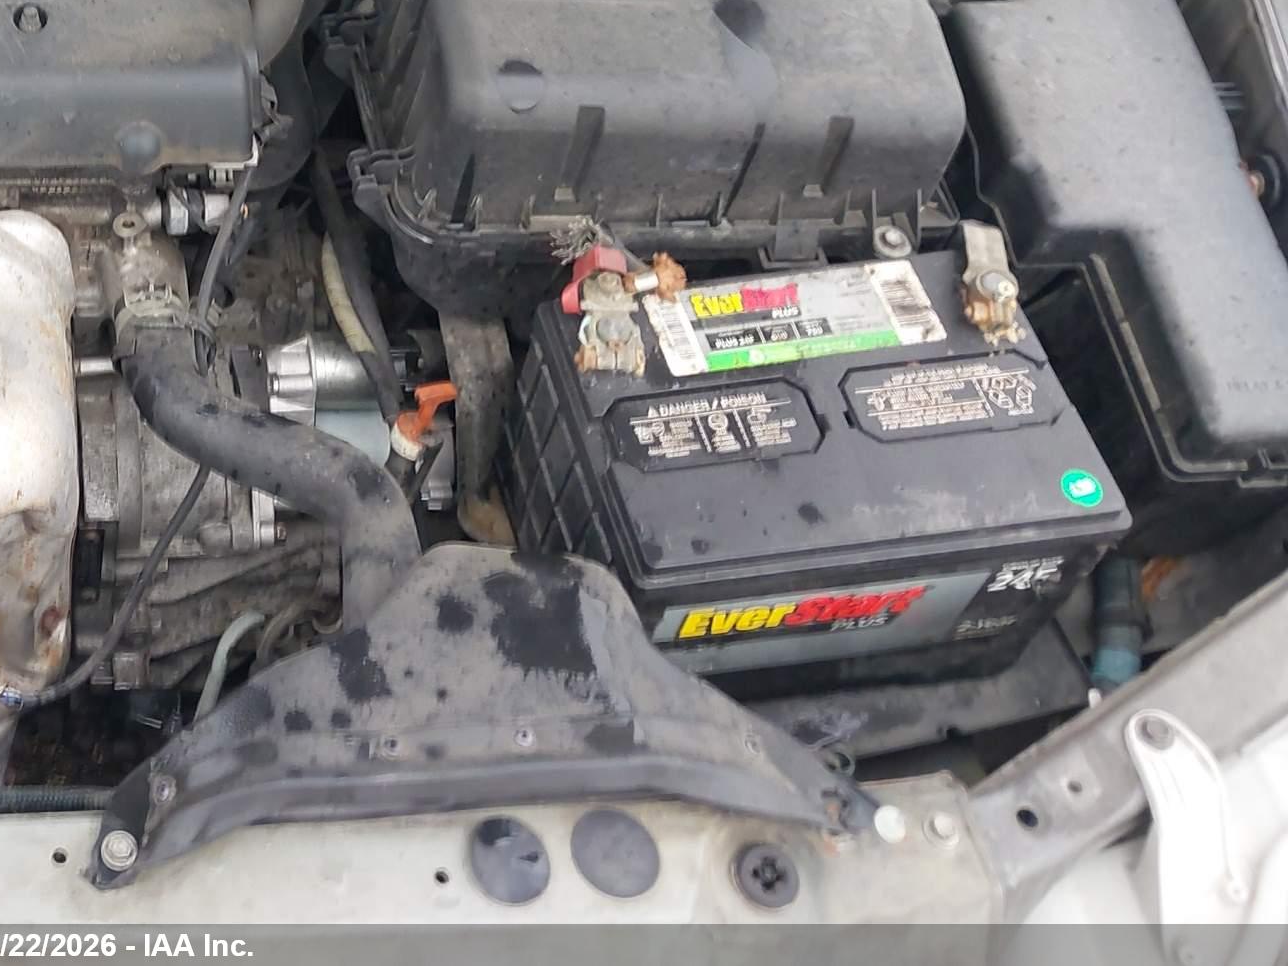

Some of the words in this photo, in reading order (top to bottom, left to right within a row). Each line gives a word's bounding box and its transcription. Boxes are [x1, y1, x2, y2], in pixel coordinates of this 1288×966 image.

[771, 306, 799, 320] PLUS
[678, 585, 928, 640] EverStart
[831, 615, 891, 633] PLUS
